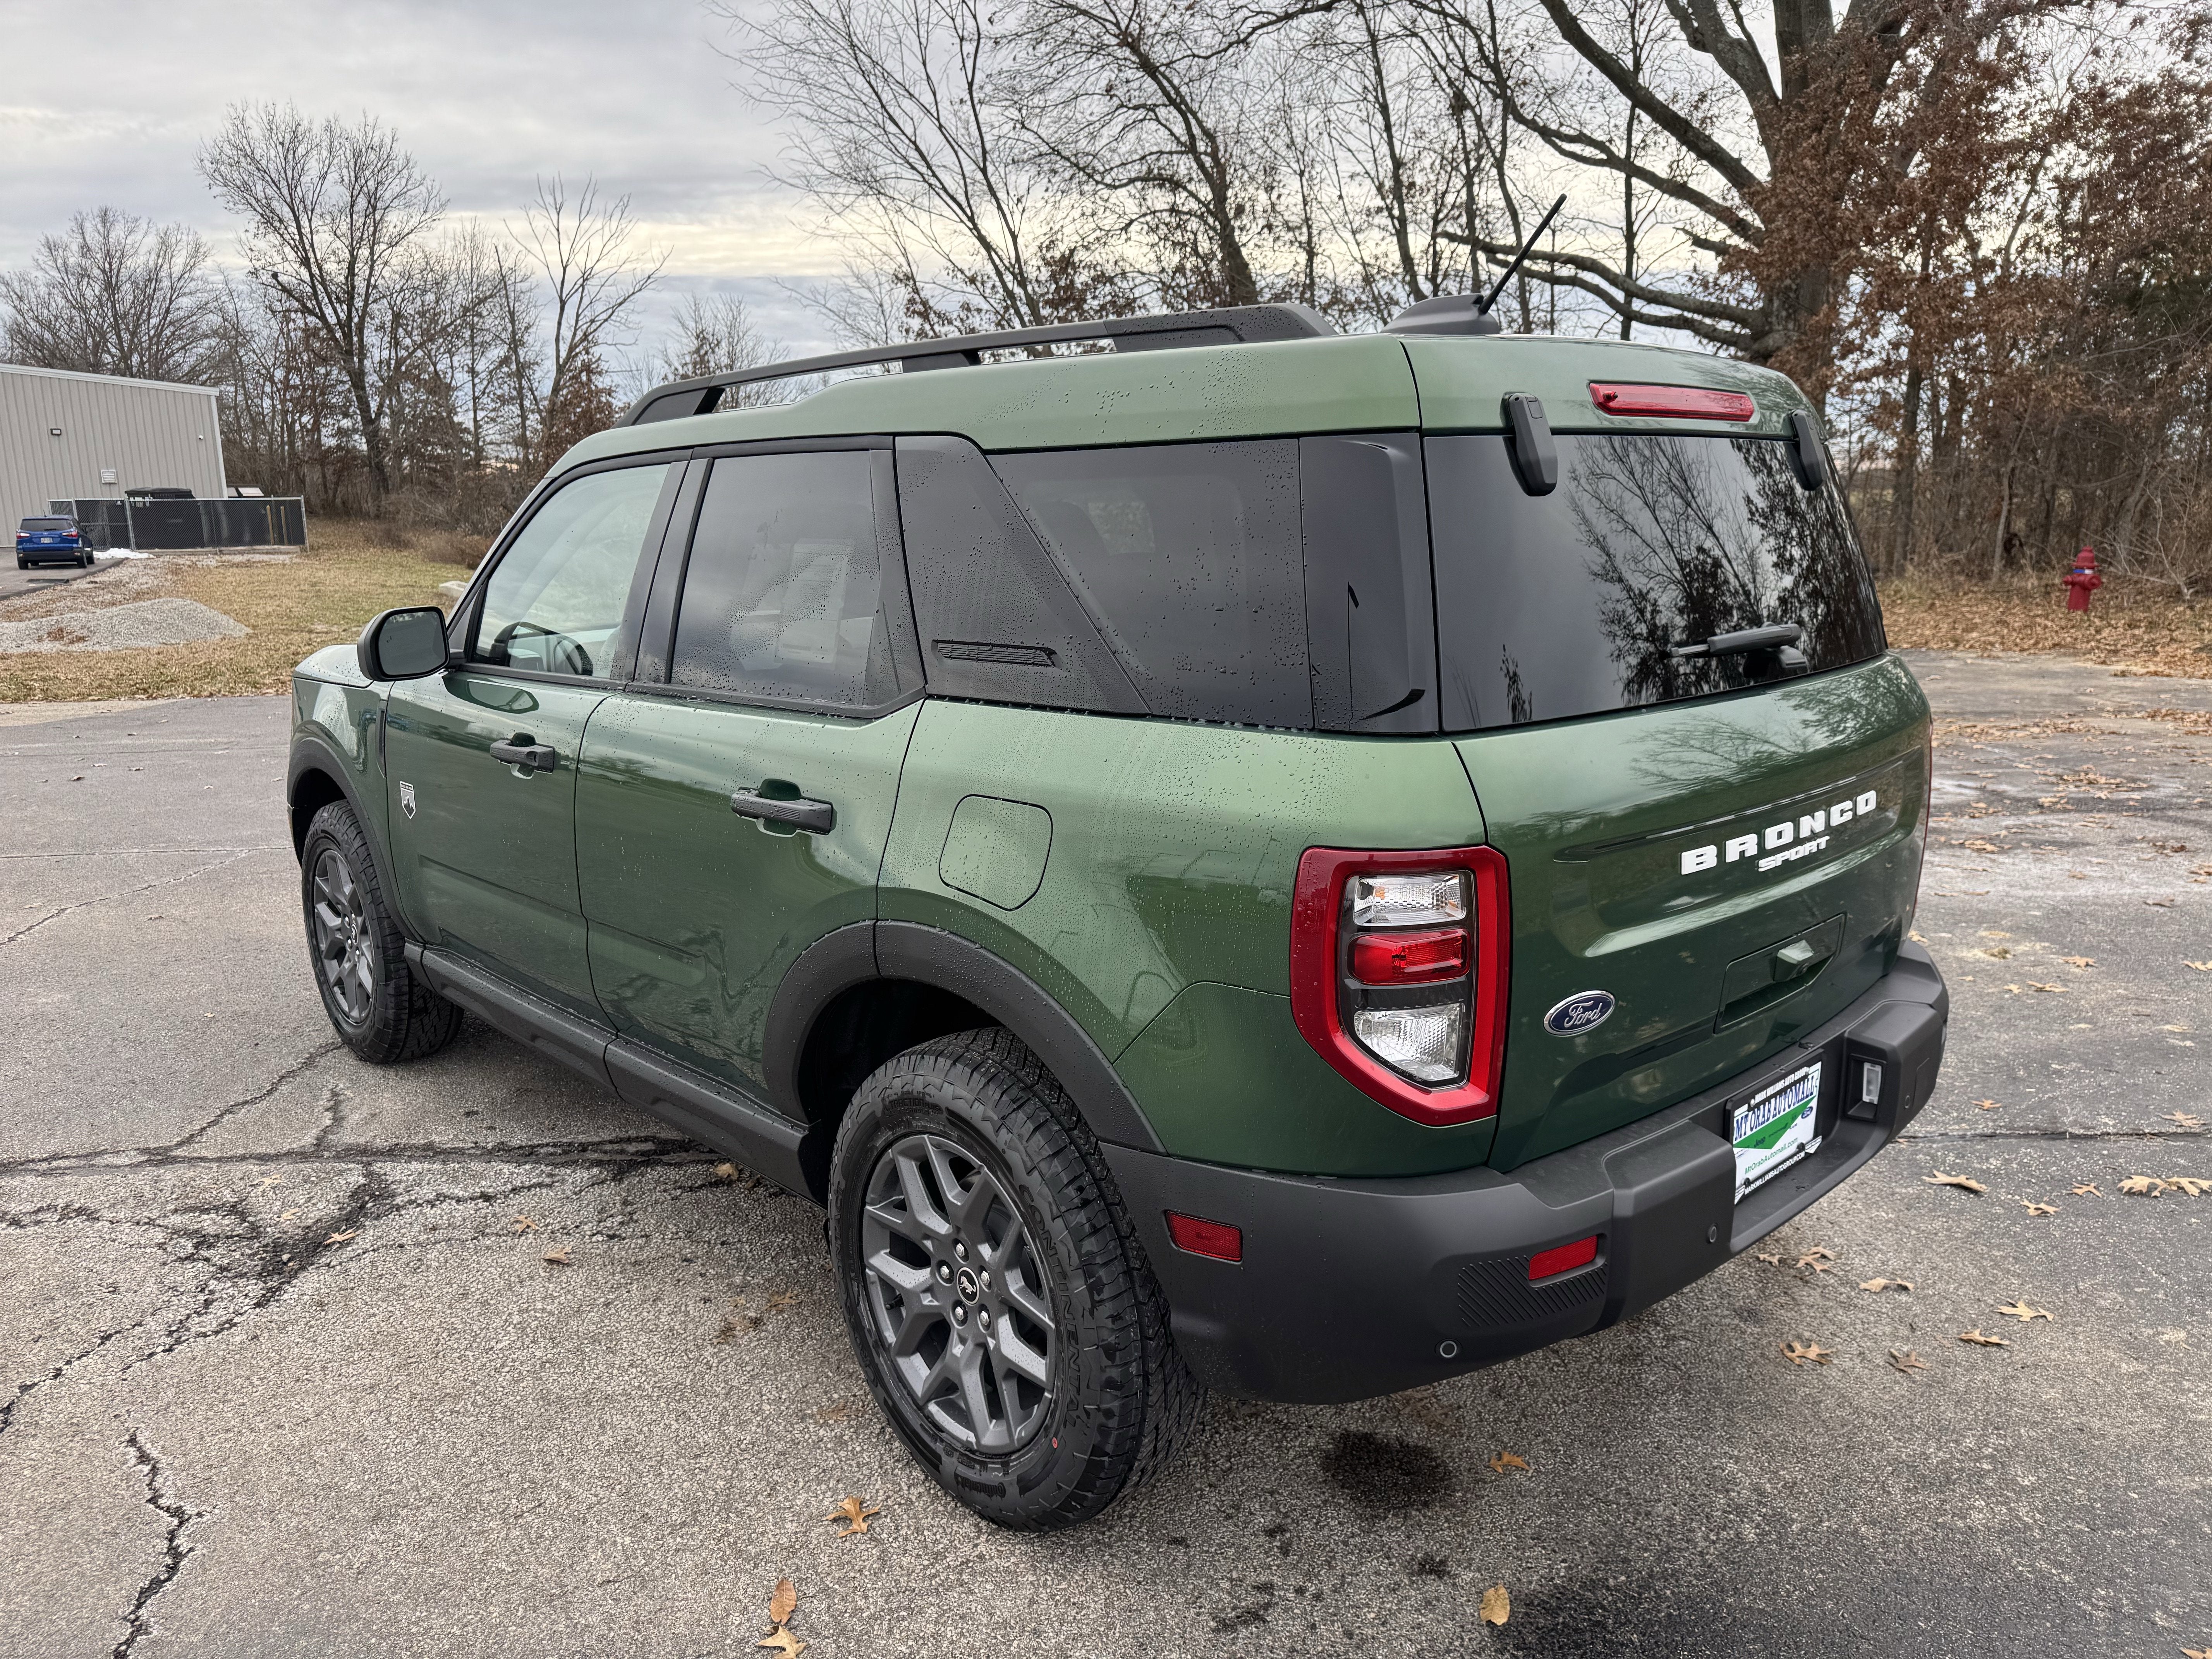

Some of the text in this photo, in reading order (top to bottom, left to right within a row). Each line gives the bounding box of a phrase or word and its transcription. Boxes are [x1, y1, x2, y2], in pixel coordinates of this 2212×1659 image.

[1681, 790, 1877, 875] BRONCO
[1757, 836, 1830, 872] SPORT
[1564, 1001, 1602, 1028] Ford
[1735, 1113, 1749, 1142] MT
[1750, 1100, 1771, 1132] ORAB
[1772, 1074, 1815, 1119] AUTOMALL
[1745, 1137, 1798, 1175] MtOrabAutomall.com
[1018, 1183, 1081, 1430] CONTINENTAL
